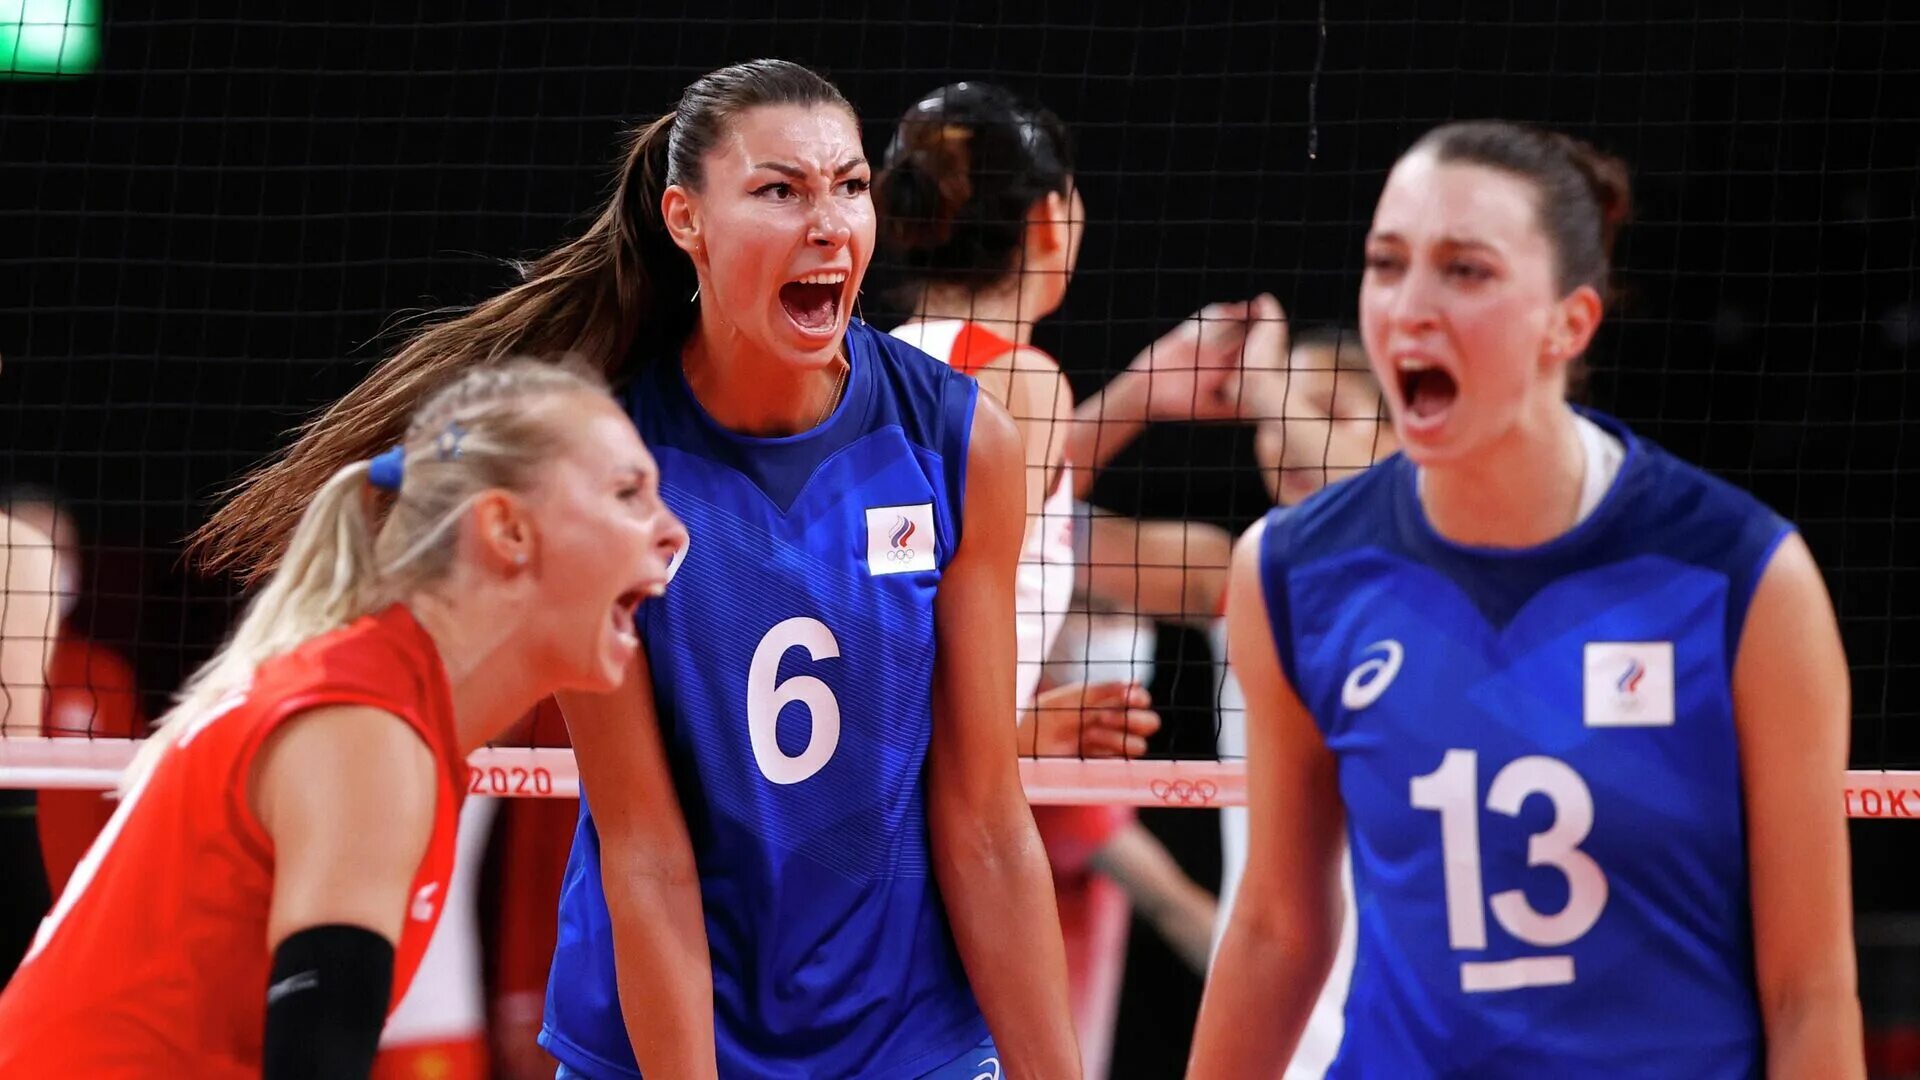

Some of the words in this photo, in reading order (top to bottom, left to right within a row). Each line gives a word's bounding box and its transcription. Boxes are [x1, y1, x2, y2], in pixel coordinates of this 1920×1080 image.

[469, 766, 553, 795] 2020
[747, 616, 841, 785] 6
[1410, 748, 1609, 950] 13
